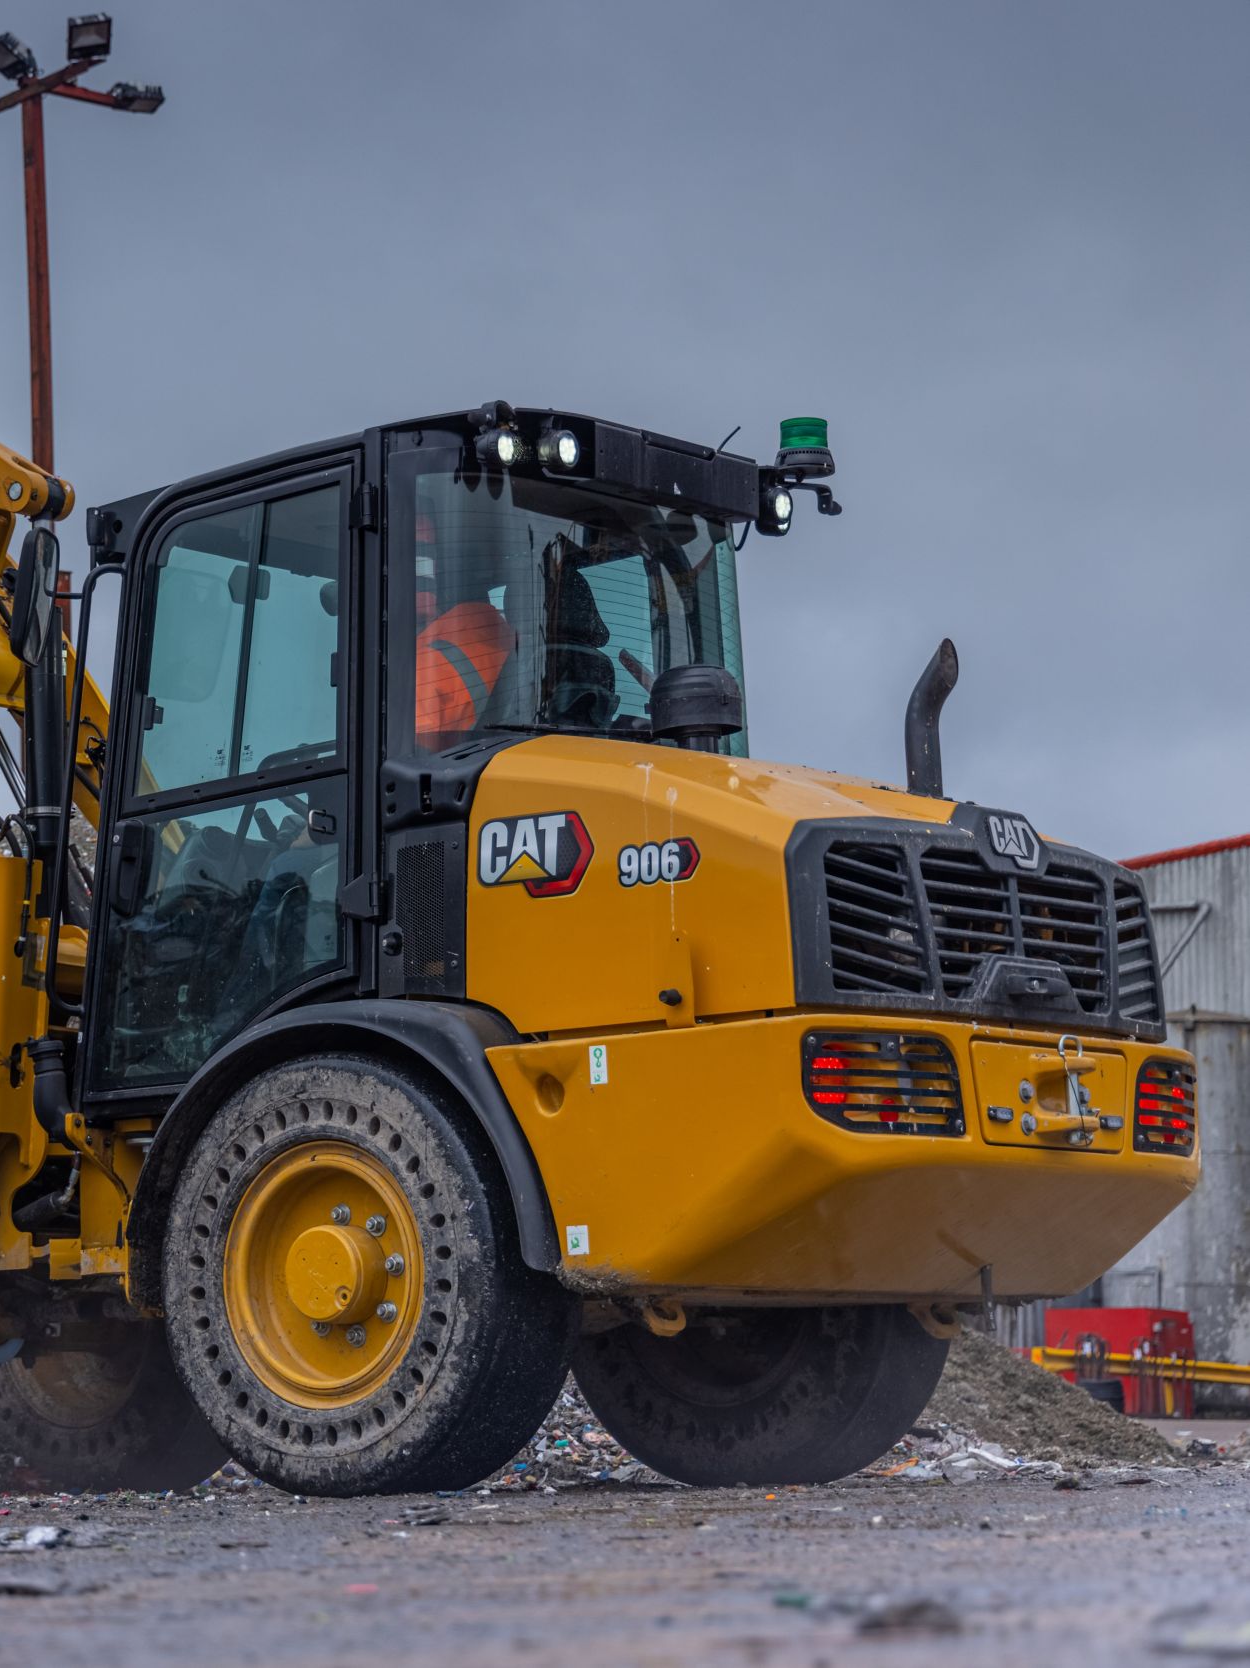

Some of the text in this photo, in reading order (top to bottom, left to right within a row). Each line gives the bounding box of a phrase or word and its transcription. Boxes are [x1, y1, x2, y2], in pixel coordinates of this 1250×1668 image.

[480, 814, 566, 884] CAT
[989, 816, 1028, 857] CAT
[620, 842, 680, 885] 906
